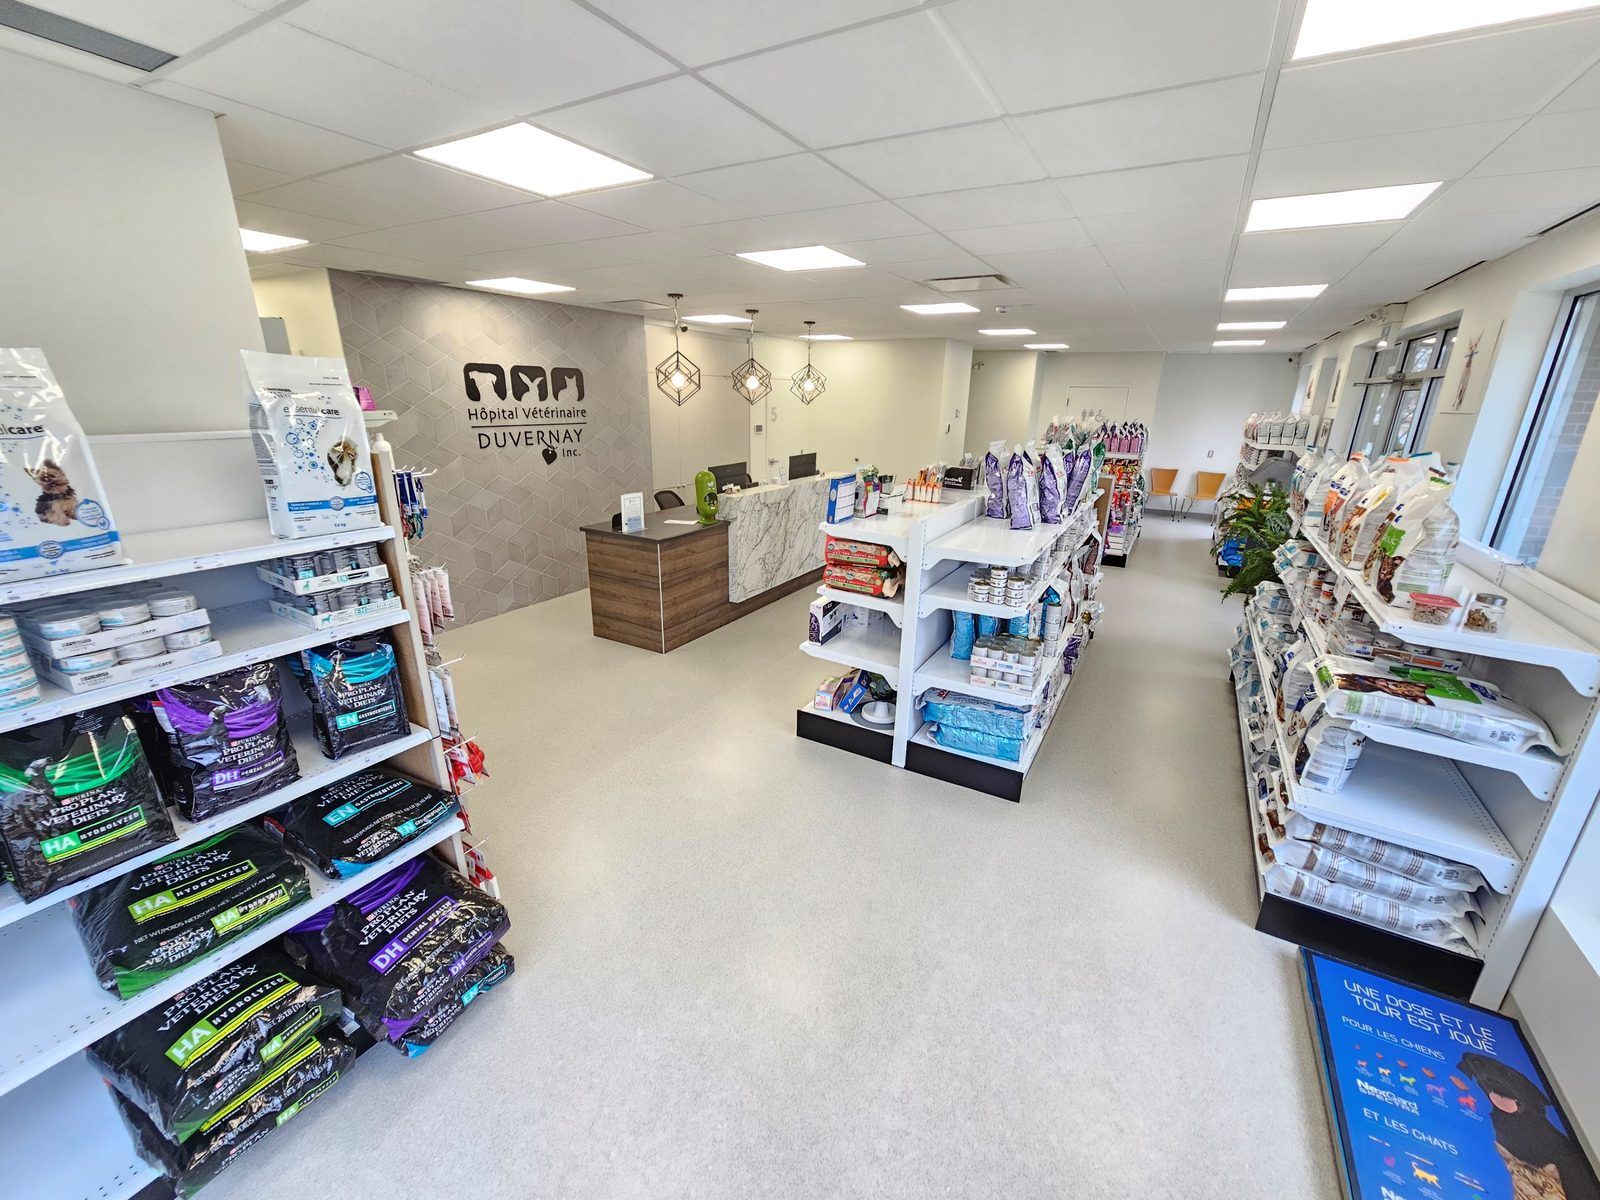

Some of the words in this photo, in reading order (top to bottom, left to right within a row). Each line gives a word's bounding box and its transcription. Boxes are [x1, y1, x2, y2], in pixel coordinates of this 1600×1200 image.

[468, 407, 518, 423] Hôpital
[522, 406, 587, 419] Vétérinaire
[771, 406, 778, 423] 5
[478, 428, 583, 449] DUVERNAY
[354, 697, 376, 708] DIETS
[358, 683, 381, 695] PLAN
[338, 714, 358, 726] EN
[216, 738, 276, 764] VETERINARY
[222, 744, 243, 756] PRO
[244, 734, 271, 749] PLAN
[237, 750, 264, 765] DIETS
[215, 771, 238, 785] DH
[264, 756, 282, 768] HEALTH
[49, 801, 80, 816] PRO
[81, 787, 118, 804] PLAN
[70, 789, 102, 802] PURINA
[317, 774, 385, 808] VETERINARY
[329, 806, 355, 823] EN
[354, 780, 404, 807] GASTROENTERIC
[342, 783, 373, 800] DIETS
[41, 791, 127, 827] VETERINARY
[70, 807, 110, 826] DIETS
[44, 837, 77, 855] HA
[80, 812, 140, 840] HYDROLYZED
[400, 823, 416, 837] EN
[130, 850, 231, 891] VETERINARY
[140, 866, 172, 882] PRO
[173, 849, 218, 869] PLAN
[165, 865, 210, 887] DIETS
[133, 893, 173, 915] HA
[176, 864, 249, 897] HYDROLYZED
[215, 910, 239, 927] HA
[359, 889, 428, 946] VETERINARY
[360, 914, 385, 936] PRO
[385, 890, 415, 918] PLAN
[373, 894, 400, 916] PURINA
[134, 934, 148, 944] NET
[149, 922, 184, 939] WT/POIDS
[374, 942, 404, 970] DH
[402, 921, 428, 943] DENTAL
[427, 901, 453, 922] HEALTH
[386, 908, 418, 935] DIETS
[172, 927, 205, 946] PLAN
[451, 958, 466, 976] DH
[157, 964, 257, 1032] VETERINARY
[163, 991, 199, 1018] PRO
[200, 963, 242, 991] PLAN
[427, 974, 445, 993] PLAN
[464, 988, 479, 1004] EN
[194, 983, 240, 1016] DIETS
[1344, 979, 1379, 1001] UNE
[1386, 994, 1433, 1018] DOSE
[1440, 1012, 1464, 1030] ET
[1470, 1024, 1493, 1041] LE
[173, 1027, 212, 1061] HA
[212, 977, 284, 1025] HYDROLYZED
[1353, 995, 1402, 1022] TOUR
[1408, 1015, 1441, 1035] EST
[1449, 1029, 1497, 1056] JOUÉ
[1342, 1016, 1374, 1034] POUR
[1376, 1029, 1398, 1043] LES
[1401, 1038, 1446, 1061] CHIENS
[208, 1082, 229, 1101] PRO
[227, 1061, 254, 1086] PLAN
[1356, 1078, 1418, 1111] NexGard
[278, 1107, 297, 1124] HA
[1358, 1086, 1421, 1117] SPECTRA
[1363, 1107, 1383, 1124] ET
[1385, 1116, 1410, 1133] LES
[1412, 1127, 1458, 1156] CHATS
[221, 1146, 243, 1166] PRO
[242, 1128, 270, 1151] PLAN
